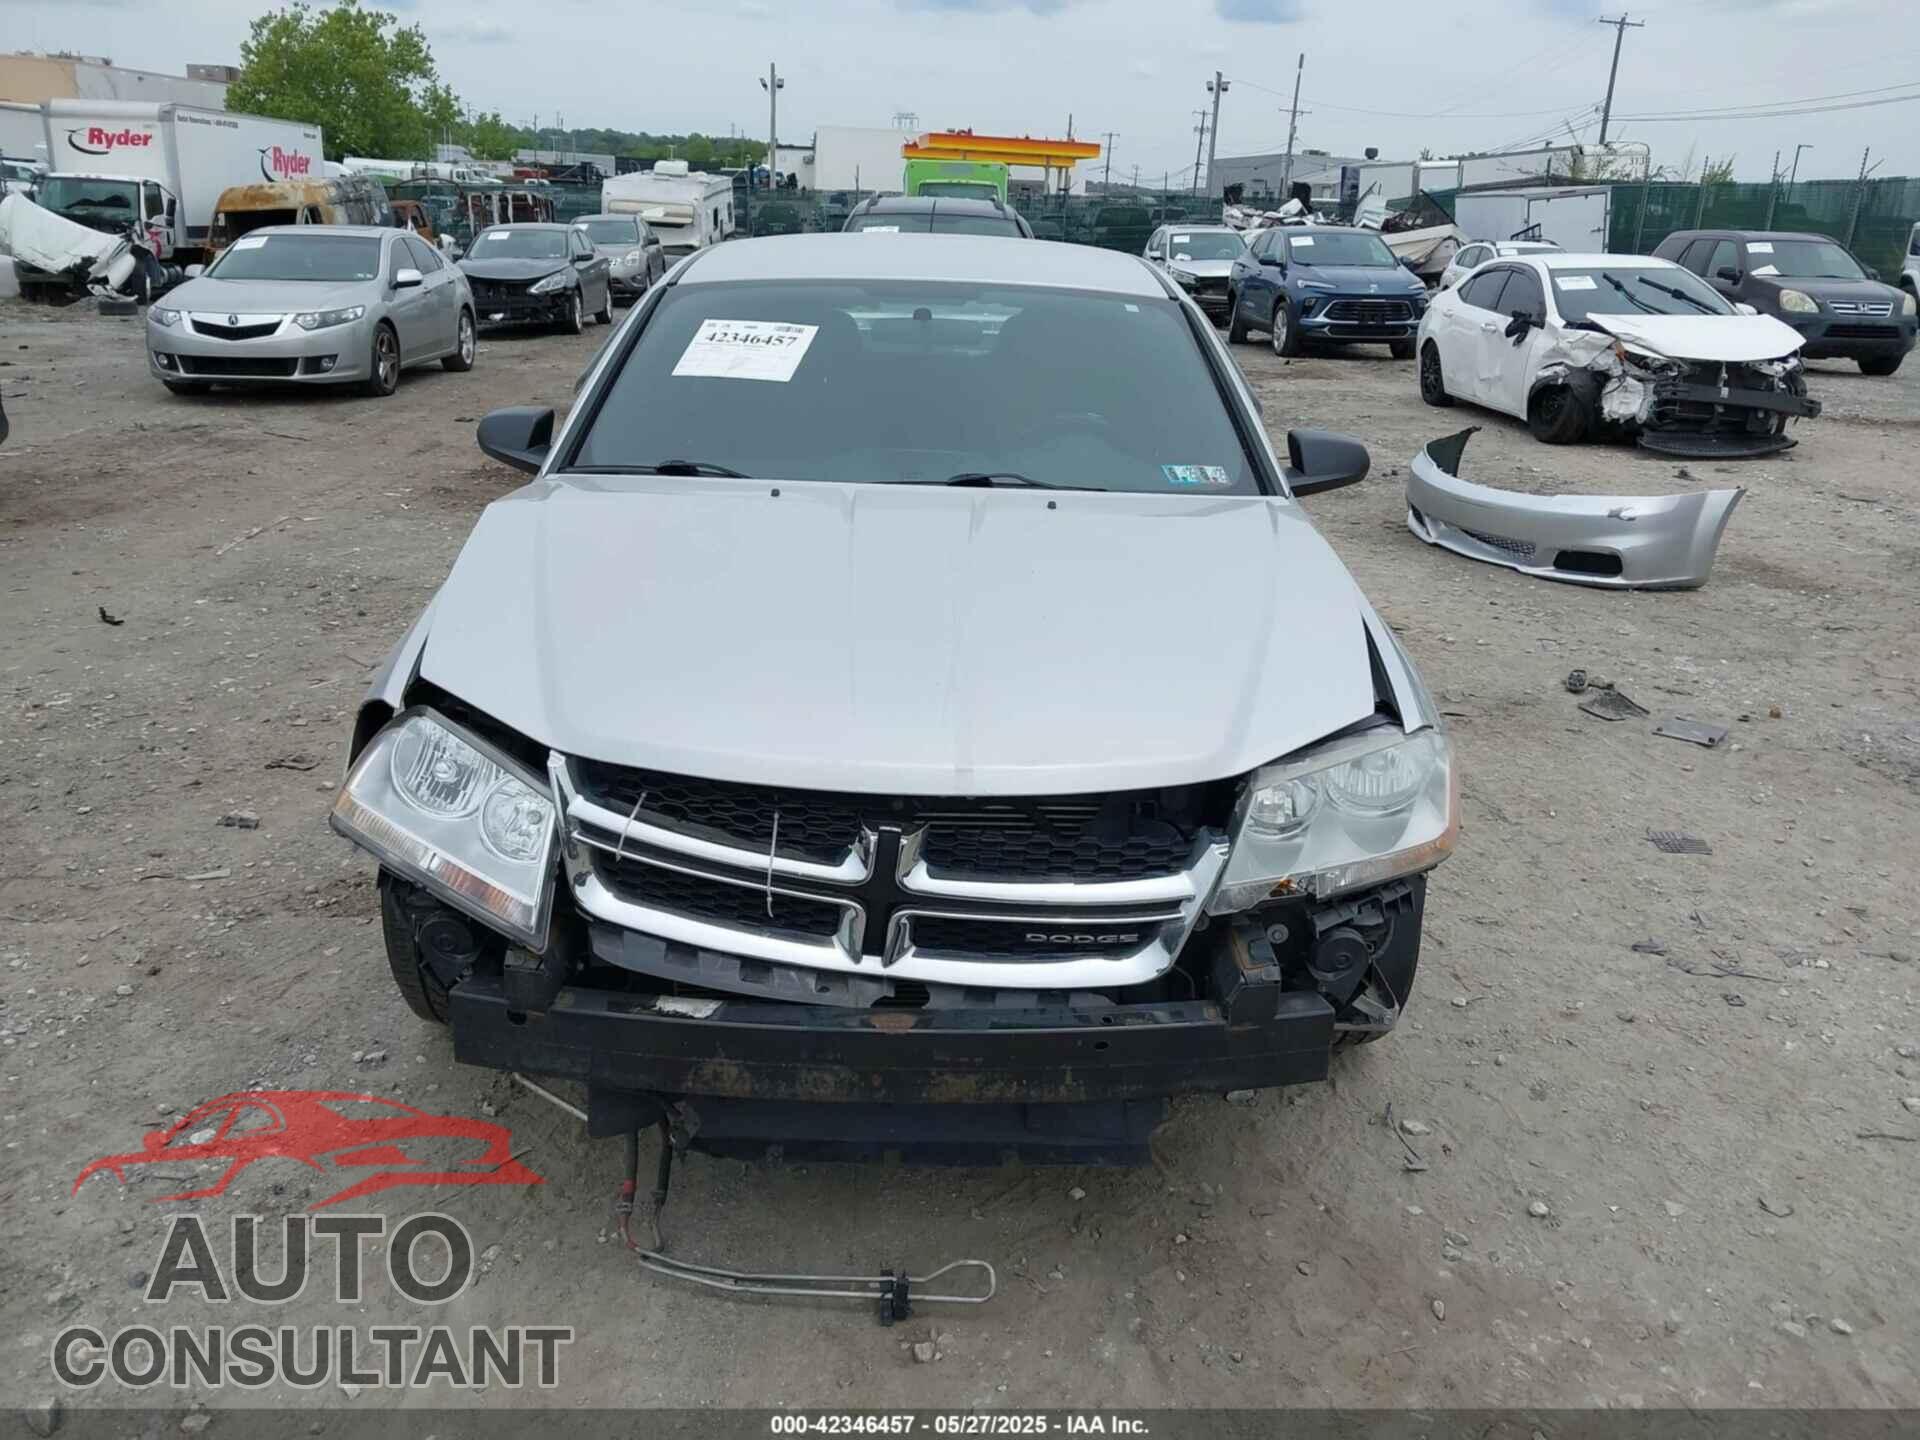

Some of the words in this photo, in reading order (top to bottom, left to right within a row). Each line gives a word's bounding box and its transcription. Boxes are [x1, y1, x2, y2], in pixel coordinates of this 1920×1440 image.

[88, 127, 152, 149] Ryder
[272, 146, 311, 176] Ryder
[704, 331, 798, 347] 42346457
[1025, 933, 1139, 944] DODGE
